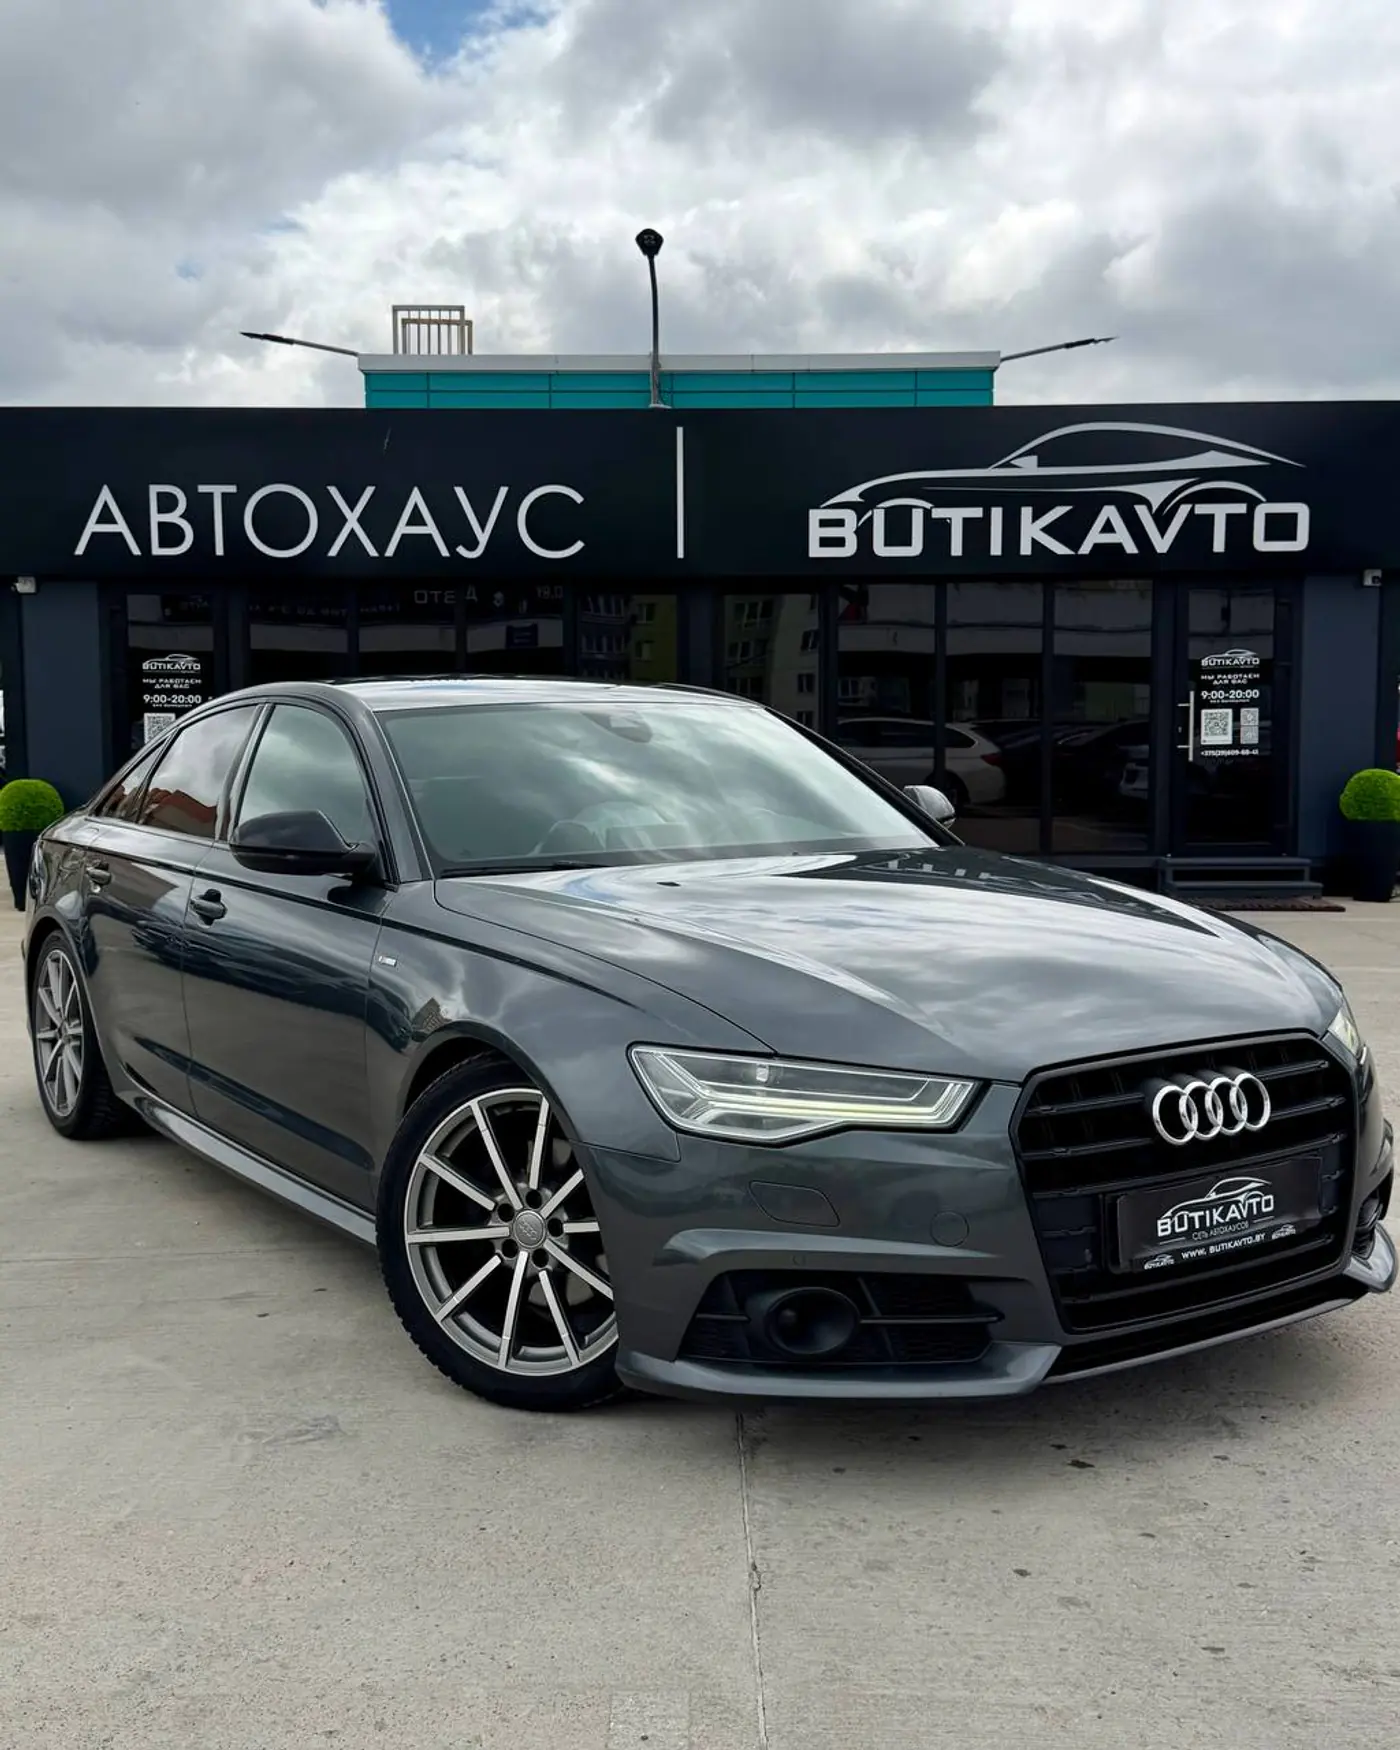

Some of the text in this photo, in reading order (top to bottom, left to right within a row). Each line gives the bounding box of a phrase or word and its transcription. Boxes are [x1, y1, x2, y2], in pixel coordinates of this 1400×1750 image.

[74, 483, 586, 560] АВТОХАУС
[808, 500, 1310, 559] BUTIKAVTO
[1201, 657, 1260, 666] BUTIKAVTO
[143, 694, 202, 704] 9:00-20:00
[1201, 689, 1260, 700] 9:00-20:00
[1157, 1194, 1274, 1237] BUTIKAVTO
